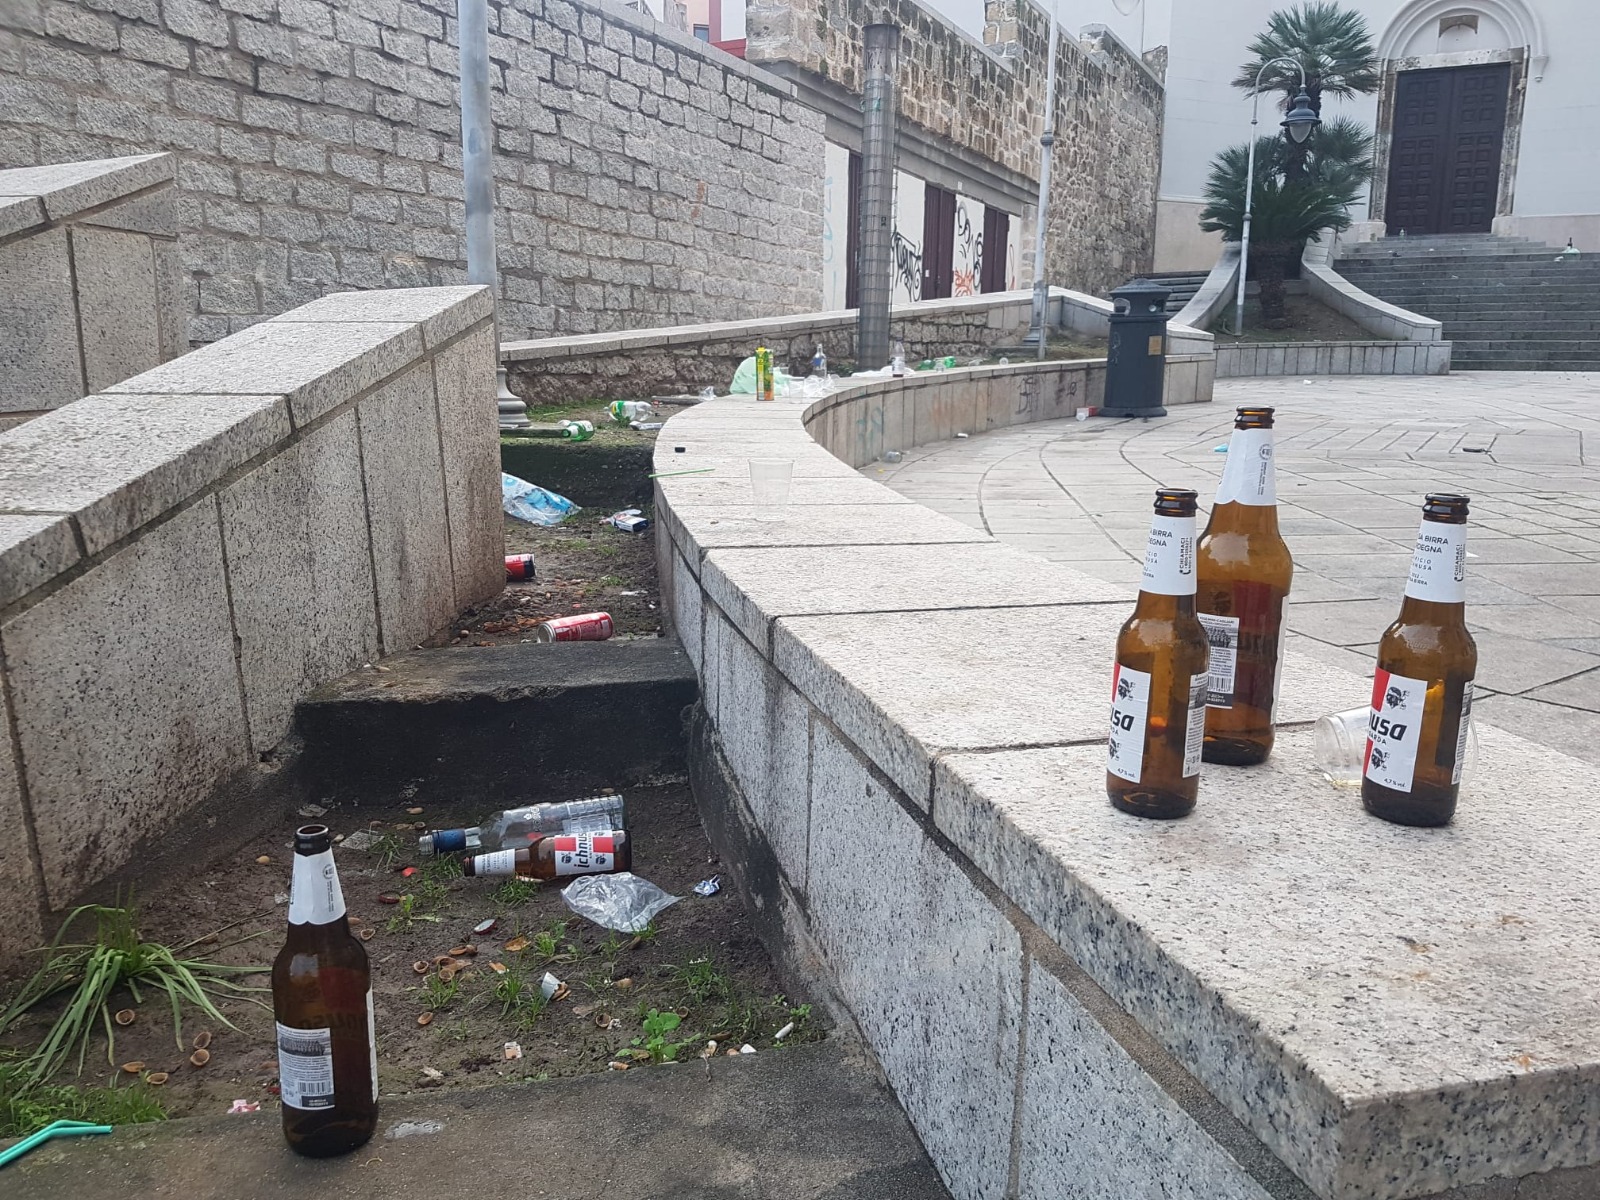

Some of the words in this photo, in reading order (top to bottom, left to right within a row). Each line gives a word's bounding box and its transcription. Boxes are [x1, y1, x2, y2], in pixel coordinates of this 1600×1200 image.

[1152, 528, 1173, 538] BIRRA
[1424, 535, 1449, 545] BIRRA
[1368, 710, 1408, 742] usa
